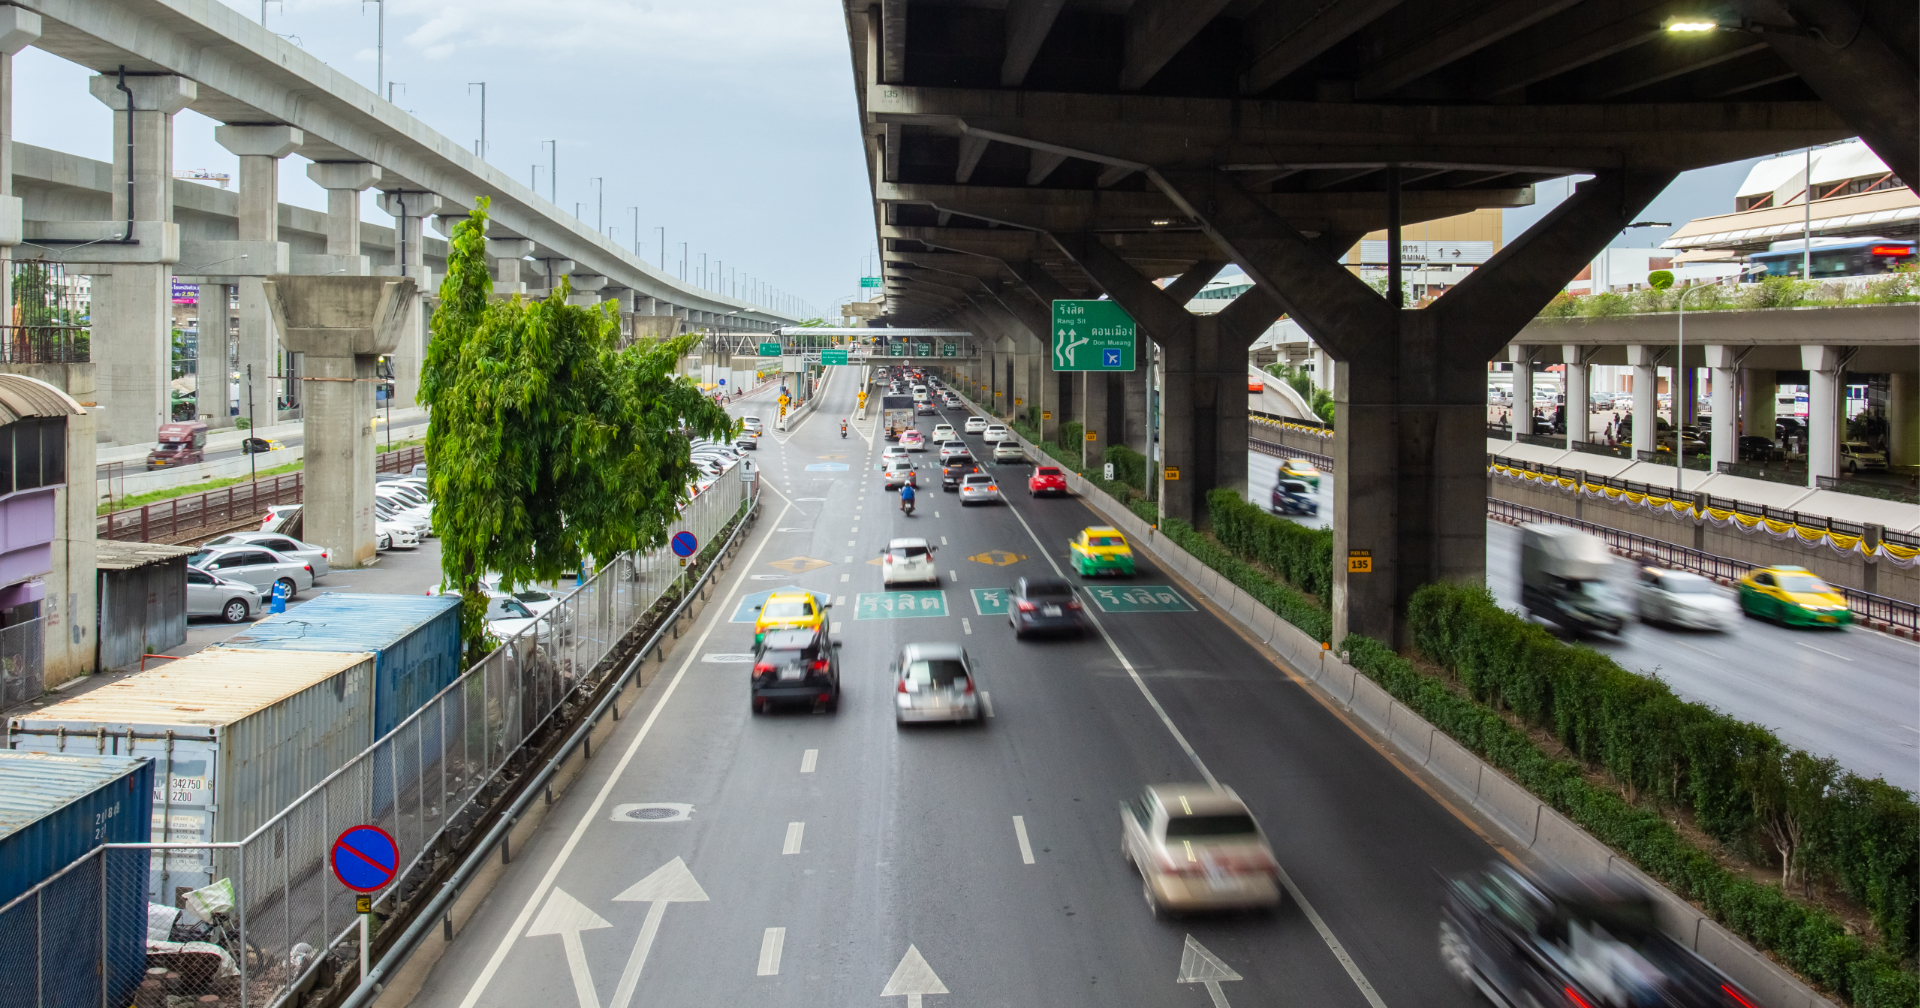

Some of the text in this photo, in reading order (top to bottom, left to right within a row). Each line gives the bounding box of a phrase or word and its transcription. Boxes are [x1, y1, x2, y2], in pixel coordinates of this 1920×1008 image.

[884, 90, 898, 98] 135
[1438, 248, 1444, 258] 1
[1060, 303, 1084, 314] รังสิต
[1092, 325, 1132, 336] ดอนเมือง
[1351, 560, 1368, 569] 135
[1097, 588, 1180, 604] รังสิต
[863, 593, 940, 612] รังสิต
[172, 778, 201, 790] 342750
[208, 780, 213, 790] 6
[172, 791, 192, 802] 2200
